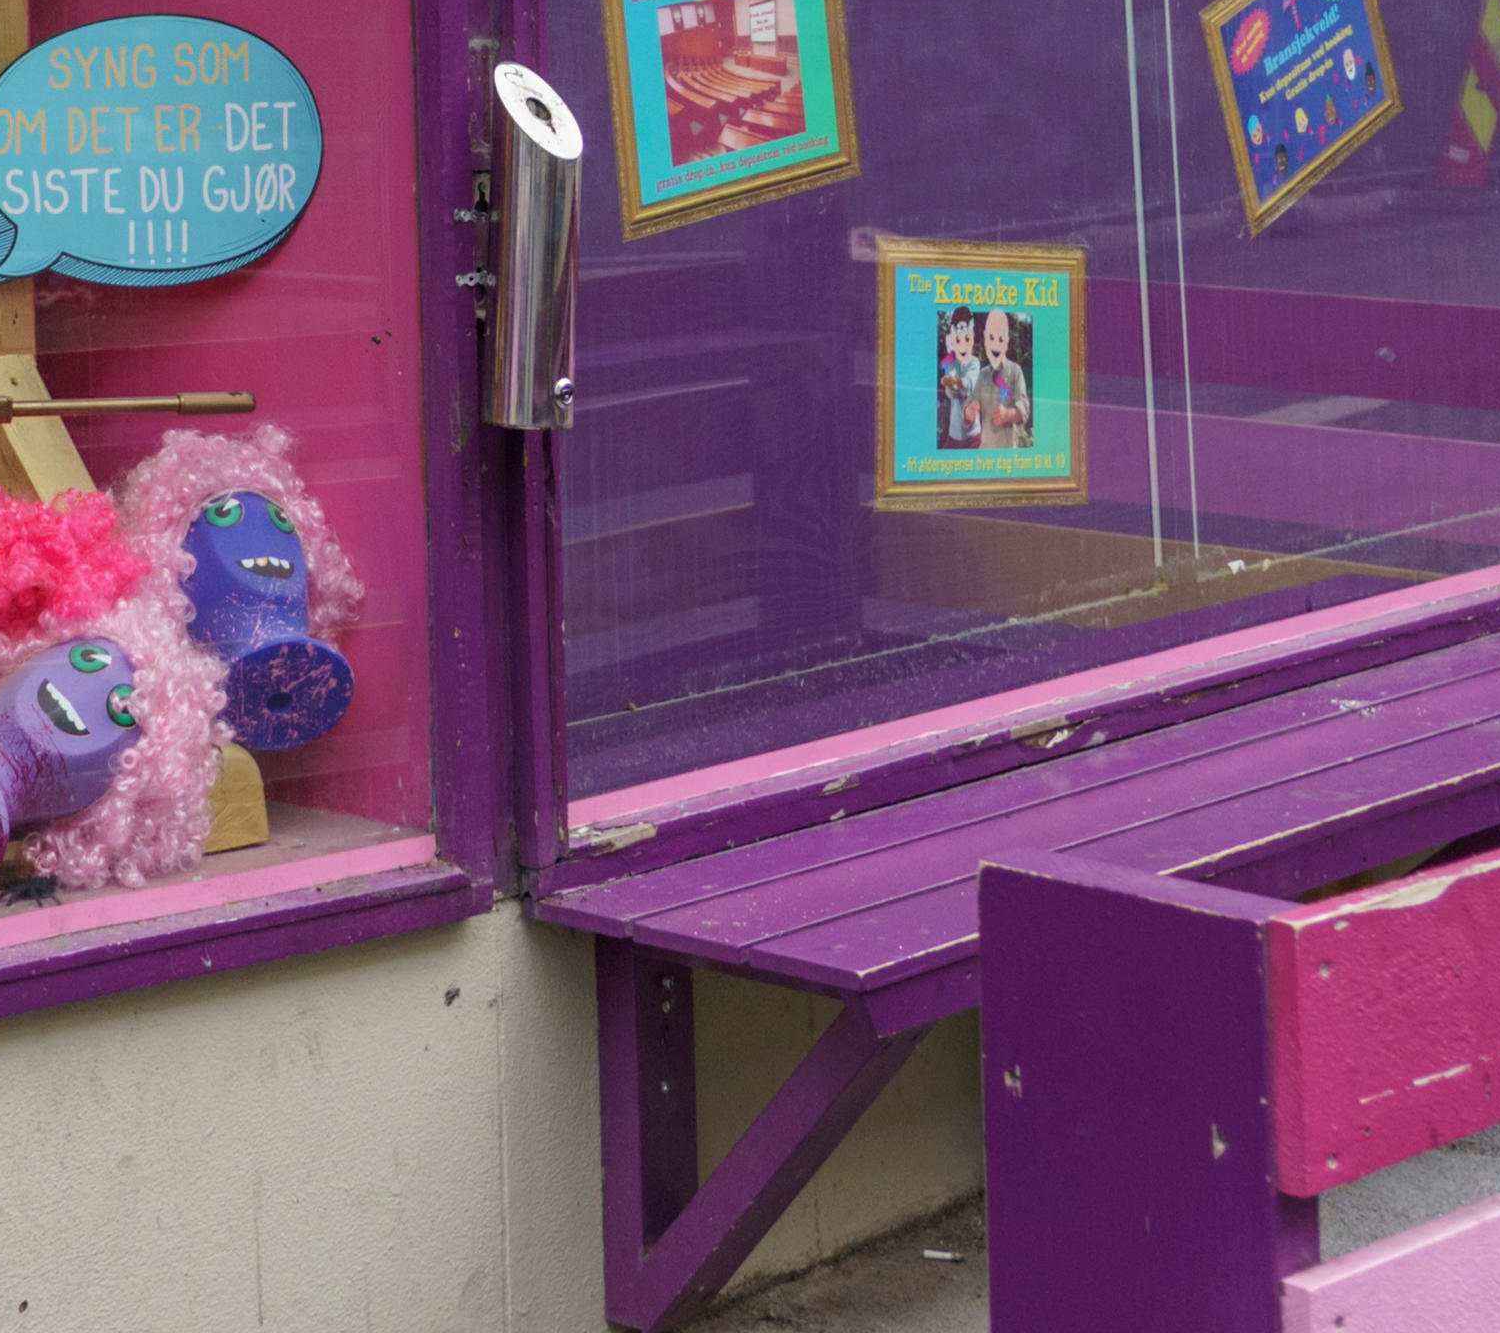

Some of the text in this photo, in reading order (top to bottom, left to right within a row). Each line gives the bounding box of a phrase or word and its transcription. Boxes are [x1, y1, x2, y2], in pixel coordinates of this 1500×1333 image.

[1263, 3, 1340, 76] Bransjekveld!
[49, 42, 250, 90] SYNG SOM
[67, 106, 139, 154] DET
[225, 101, 297, 153] DET
[2, 163, 296, 215] SISTE DU GJØR
[128, 220, 188, 265] !!!!
[907, 274, 1059, 307] The Karaoke Kid
